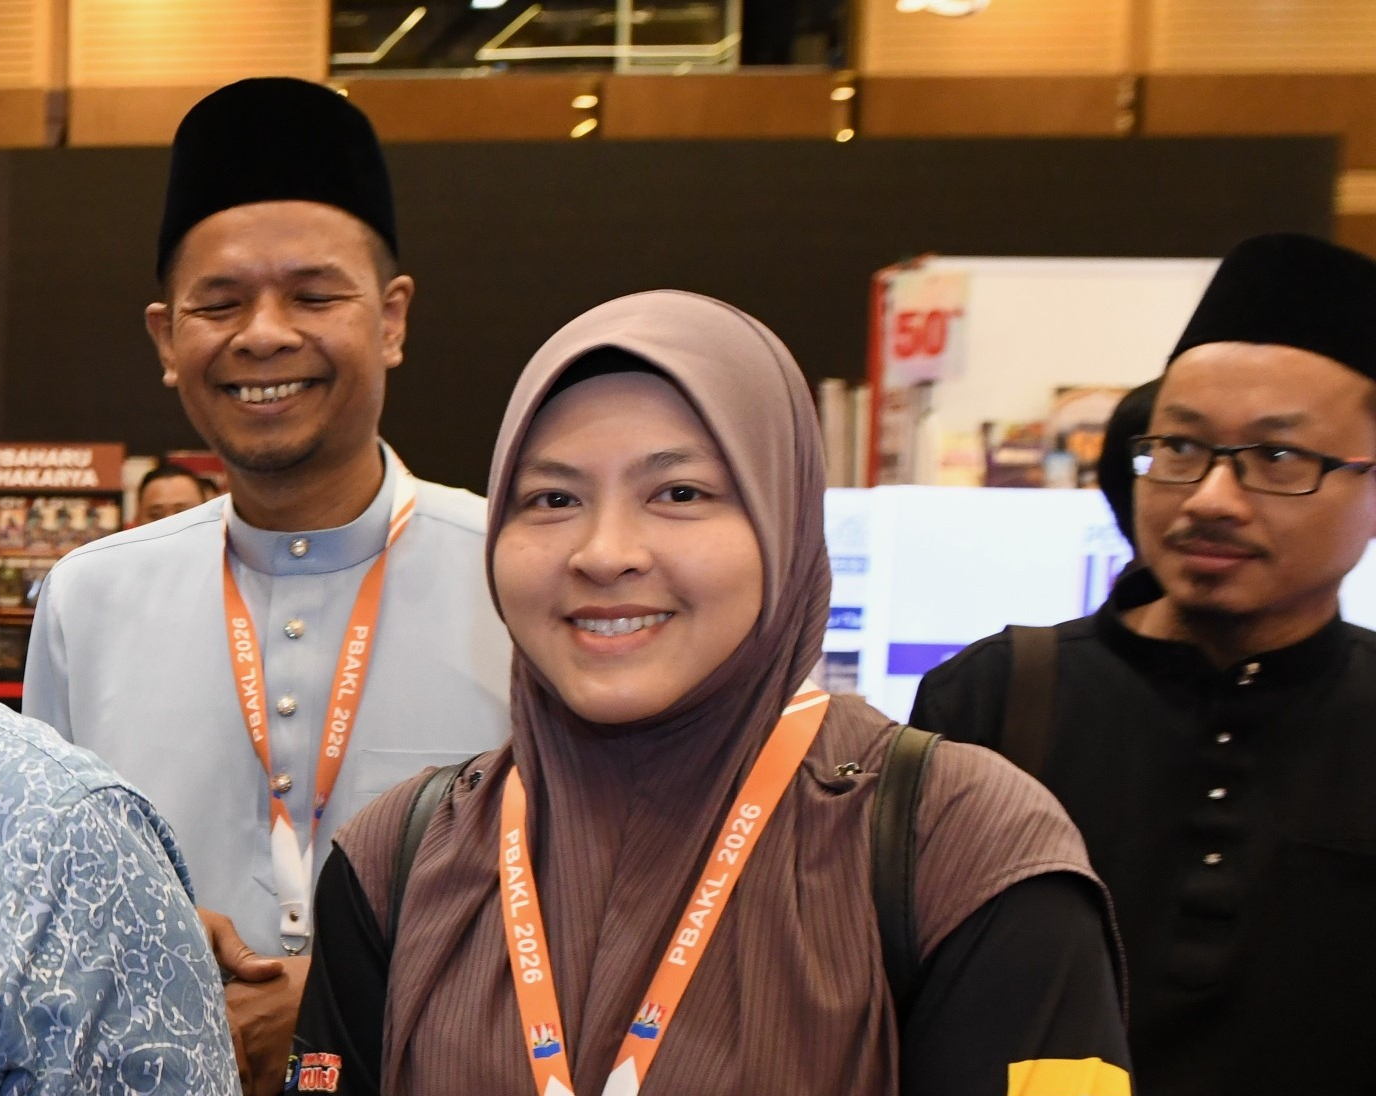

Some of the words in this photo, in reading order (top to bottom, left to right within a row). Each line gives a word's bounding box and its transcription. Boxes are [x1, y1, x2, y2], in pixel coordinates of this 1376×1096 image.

[231, 617, 254, 663] 2026
[336, 625, 370, 701] PBAKL
[240, 667, 265, 743] PBAKL
[325, 706, 351, 759] 2026
[505, 828, 530, 918] PBAKL
[667, 871, 729, 966] PBAKL
[717, 802, 763, 866] 2026
[513, 923, 544, 984] 2026
